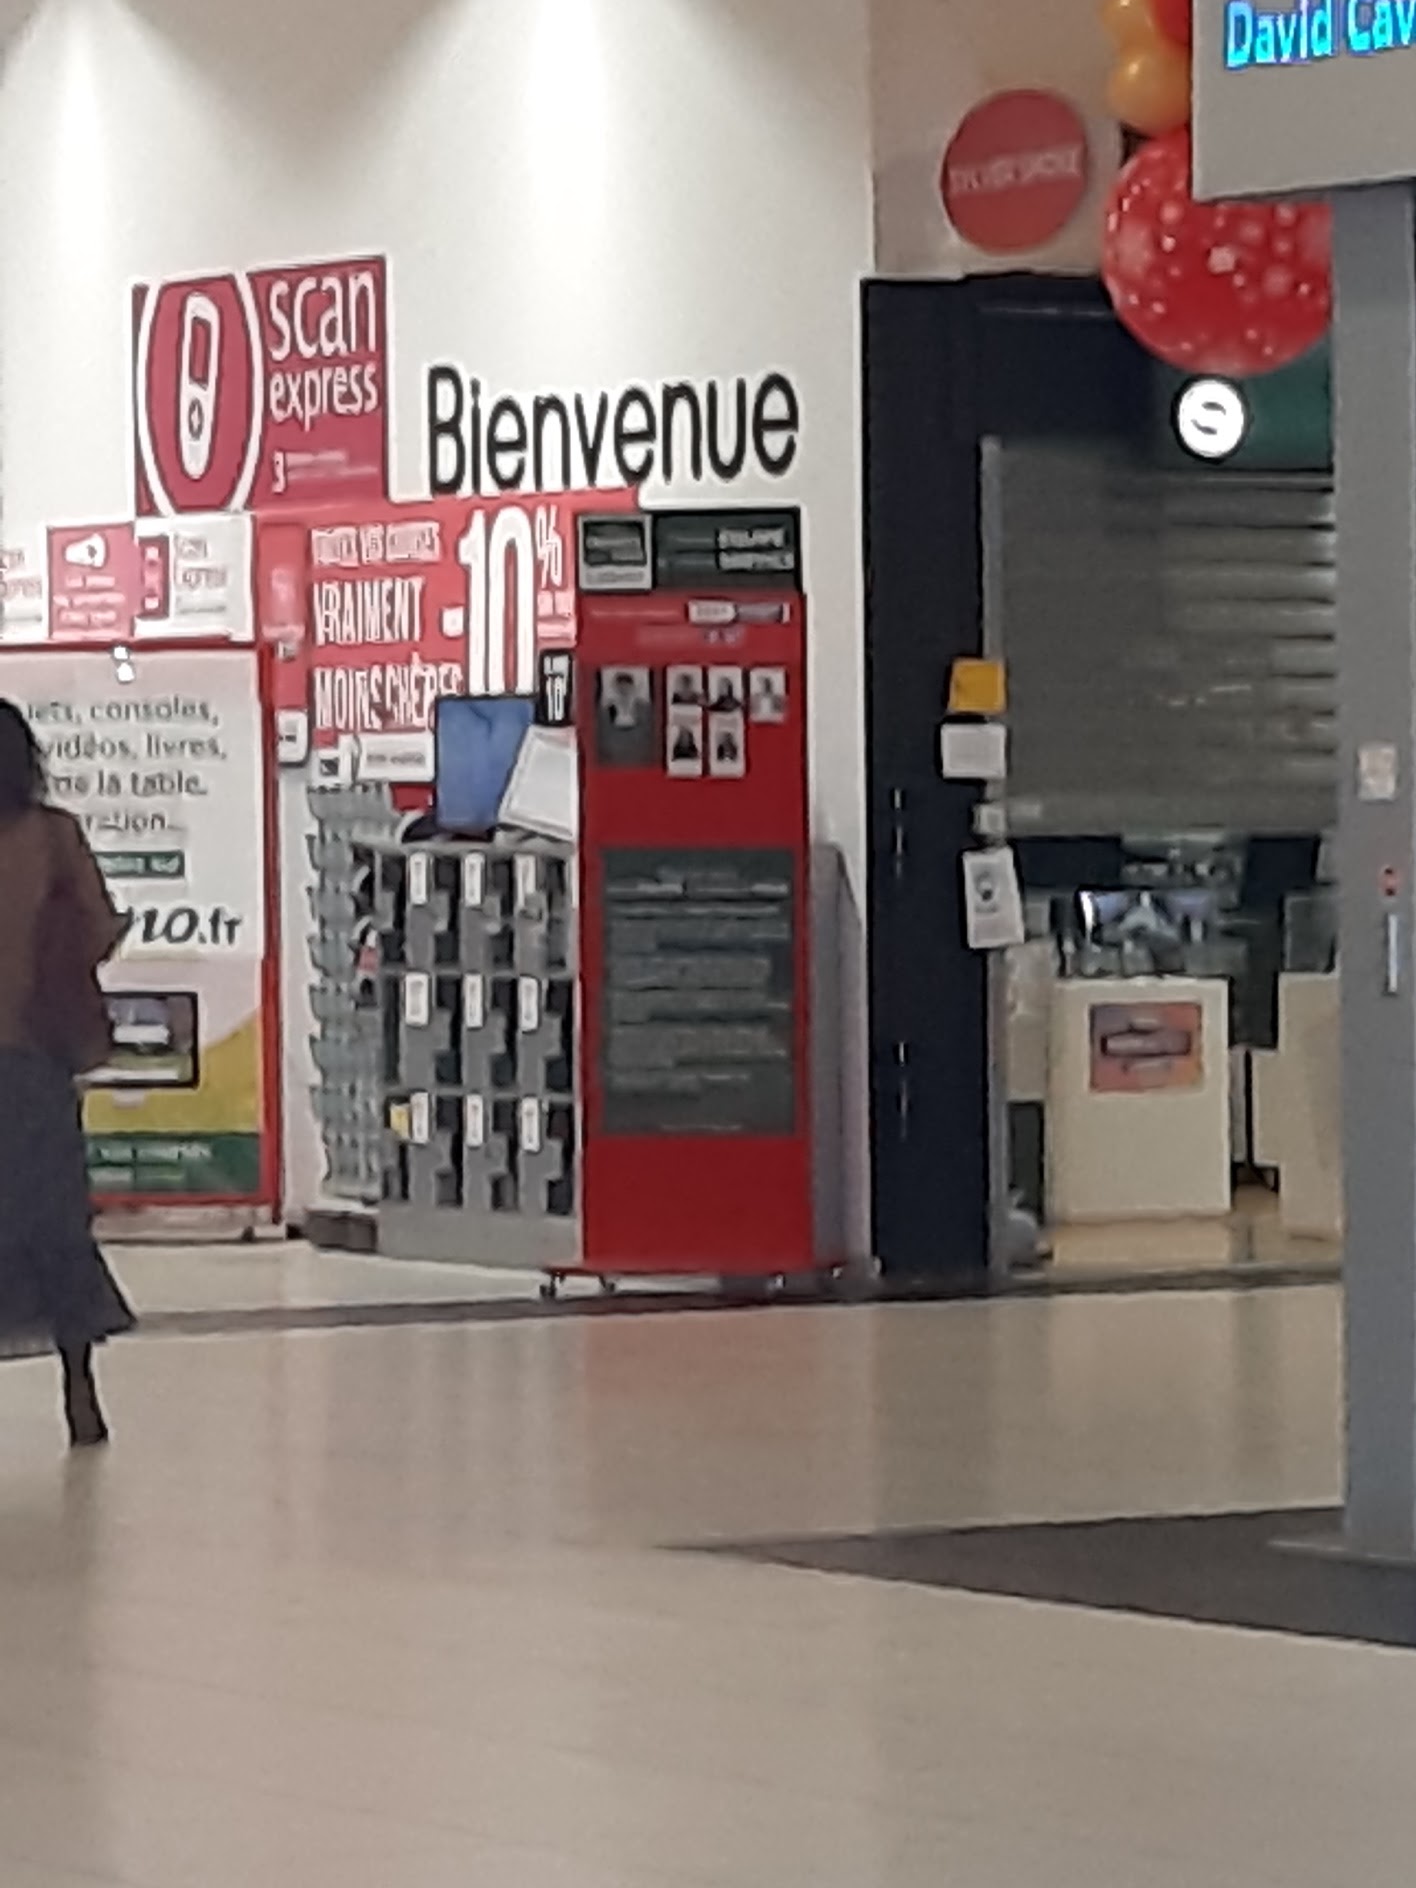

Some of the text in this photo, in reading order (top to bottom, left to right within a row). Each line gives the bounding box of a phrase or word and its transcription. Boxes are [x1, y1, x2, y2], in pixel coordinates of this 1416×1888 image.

[269, 270, 376, 362] scan
[270, 363, 379, 432] express
[428, 365, 800, 496] Bienvenue
[313, 575, 426, 647] VRAIMENT
[90, 695, 219, 726] consoles,
[314, 664, 383, 730] MOINS
[98, 769, 122, 797] la
